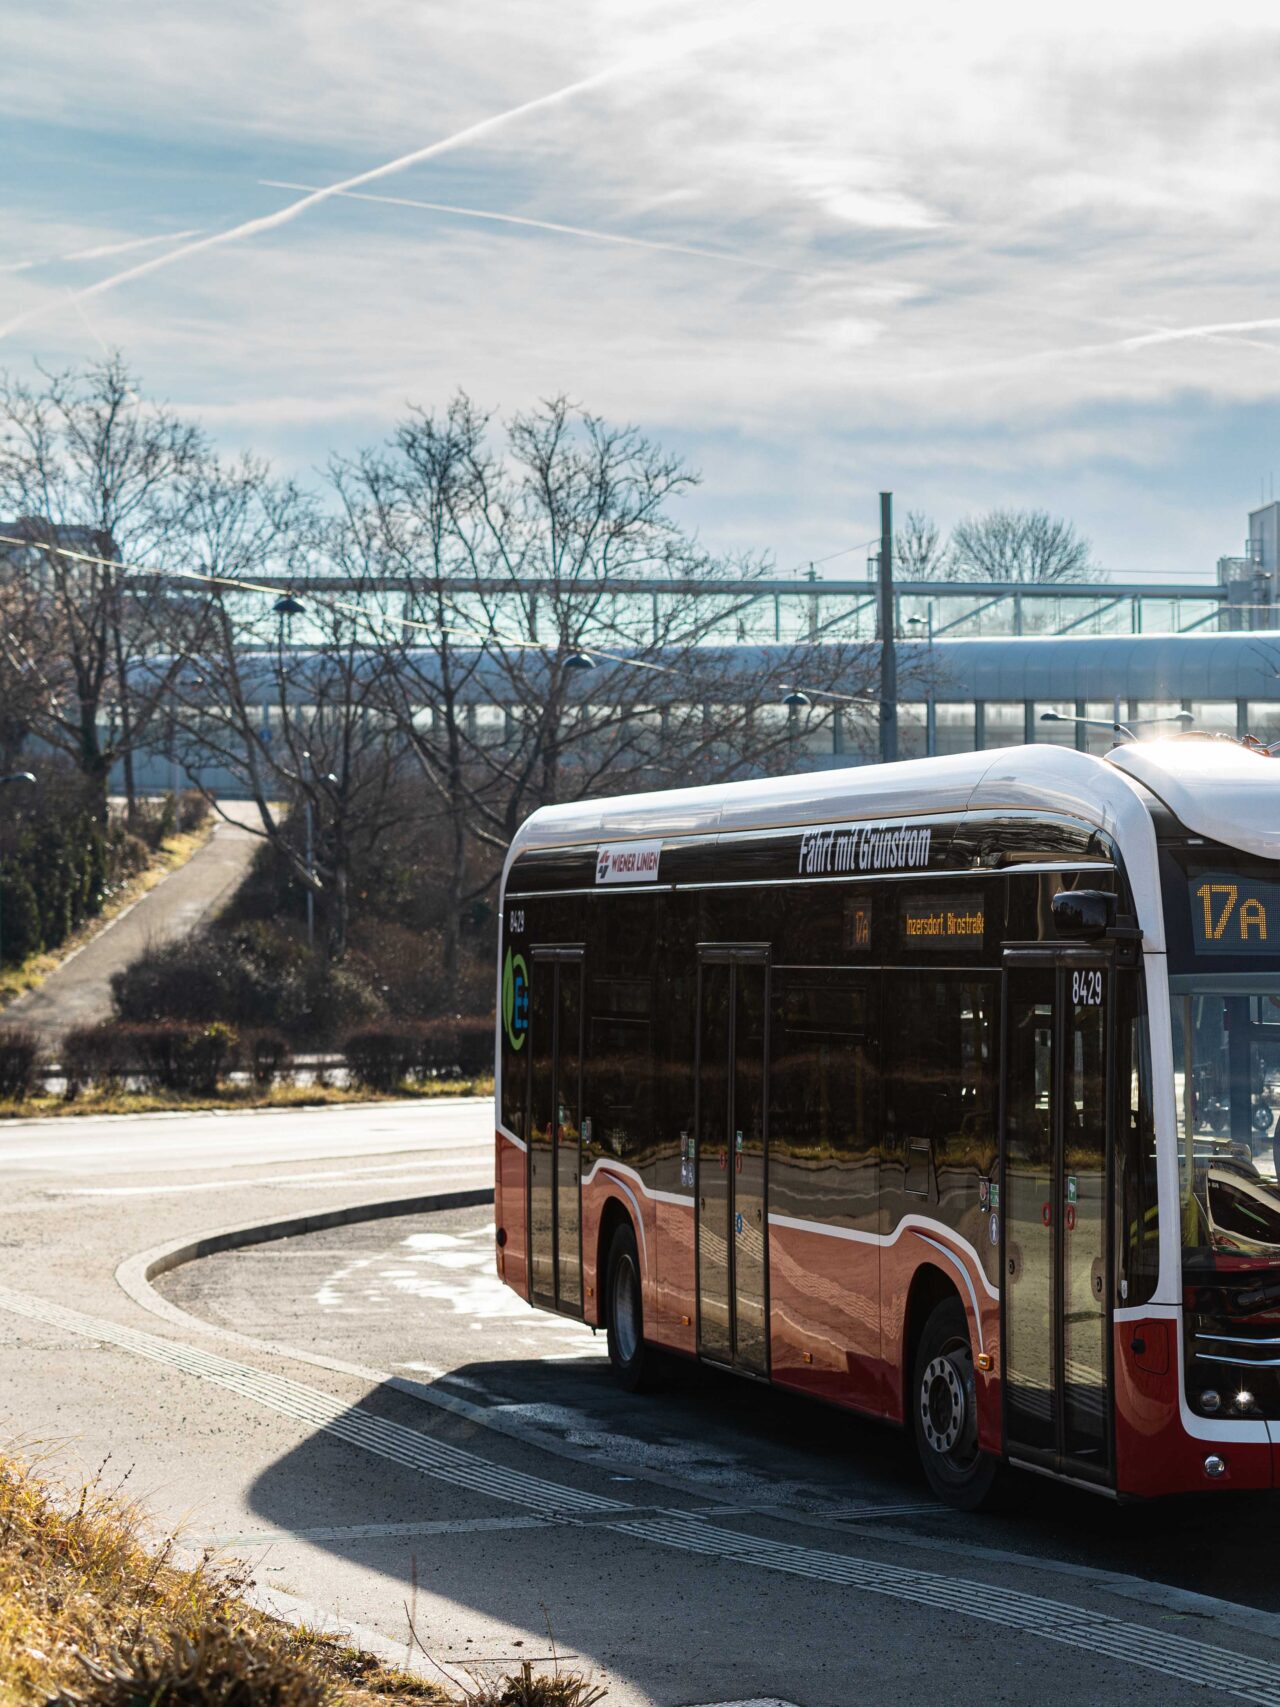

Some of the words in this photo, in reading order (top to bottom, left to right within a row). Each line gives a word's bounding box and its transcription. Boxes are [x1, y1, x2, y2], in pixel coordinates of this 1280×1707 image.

[611, 853, 636, 873] WIENER
[635, 851, 660, 872] LINIEN
[798, 828, 835, 874] Fährt
[834, 825, 860, 871] mit
[859, 822, 931, 870] Grünstrom
[510, 910, 525, 933] 8429
[906, 912, 946, 936] Inzersdorf,
[1197, 884, 1268, 940] 17A
[1072, 970, 1102, 1005] 8429
